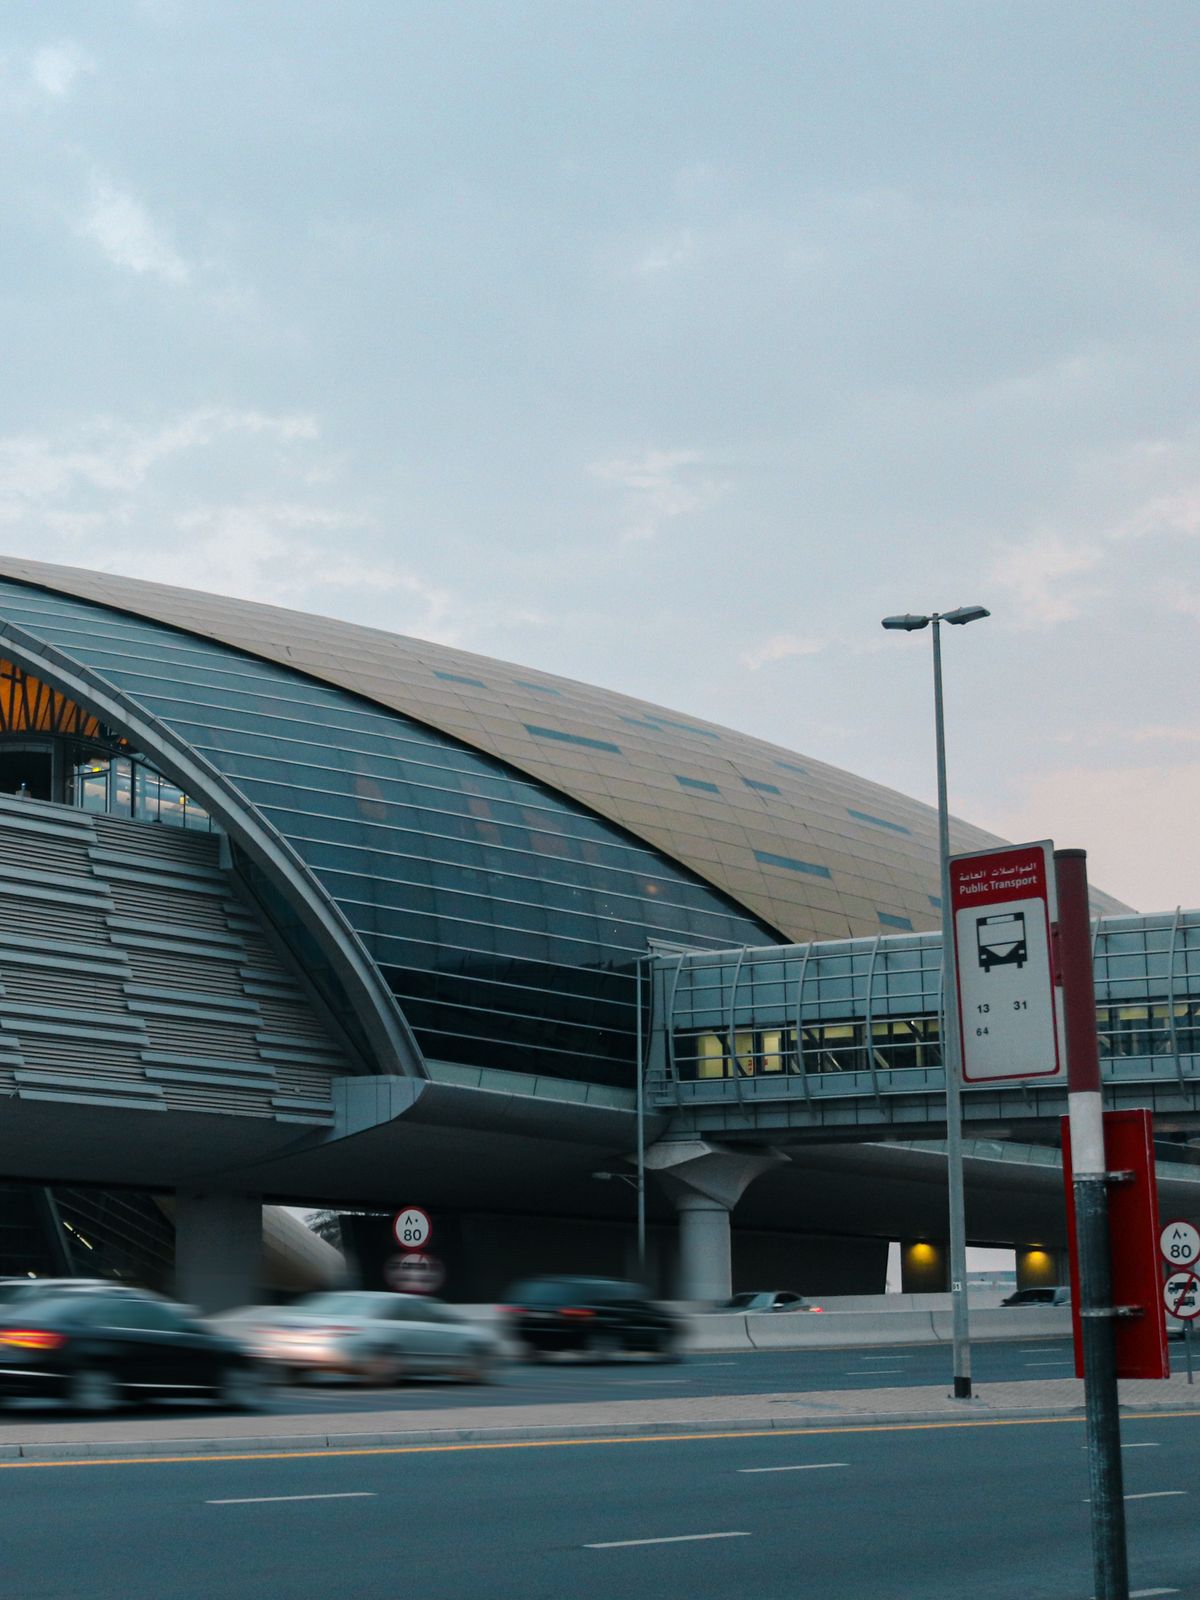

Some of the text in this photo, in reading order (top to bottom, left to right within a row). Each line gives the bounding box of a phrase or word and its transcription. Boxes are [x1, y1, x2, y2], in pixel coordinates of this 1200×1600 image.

[959, 862, 1037, 881] المواصلات العامة
[959, 874, 1038, 895] Public Transport
[976, 1000, 1028, 1014] 13 31
[976, 1027, 989, 1037] 64
[405, 1215, 419, 1226] ٨٠
[404, 1229, 422, 1241] 80
[1172, 1227, 1188, 1240] ٨٠
[1170, 1244, 1192, 1259] 80
